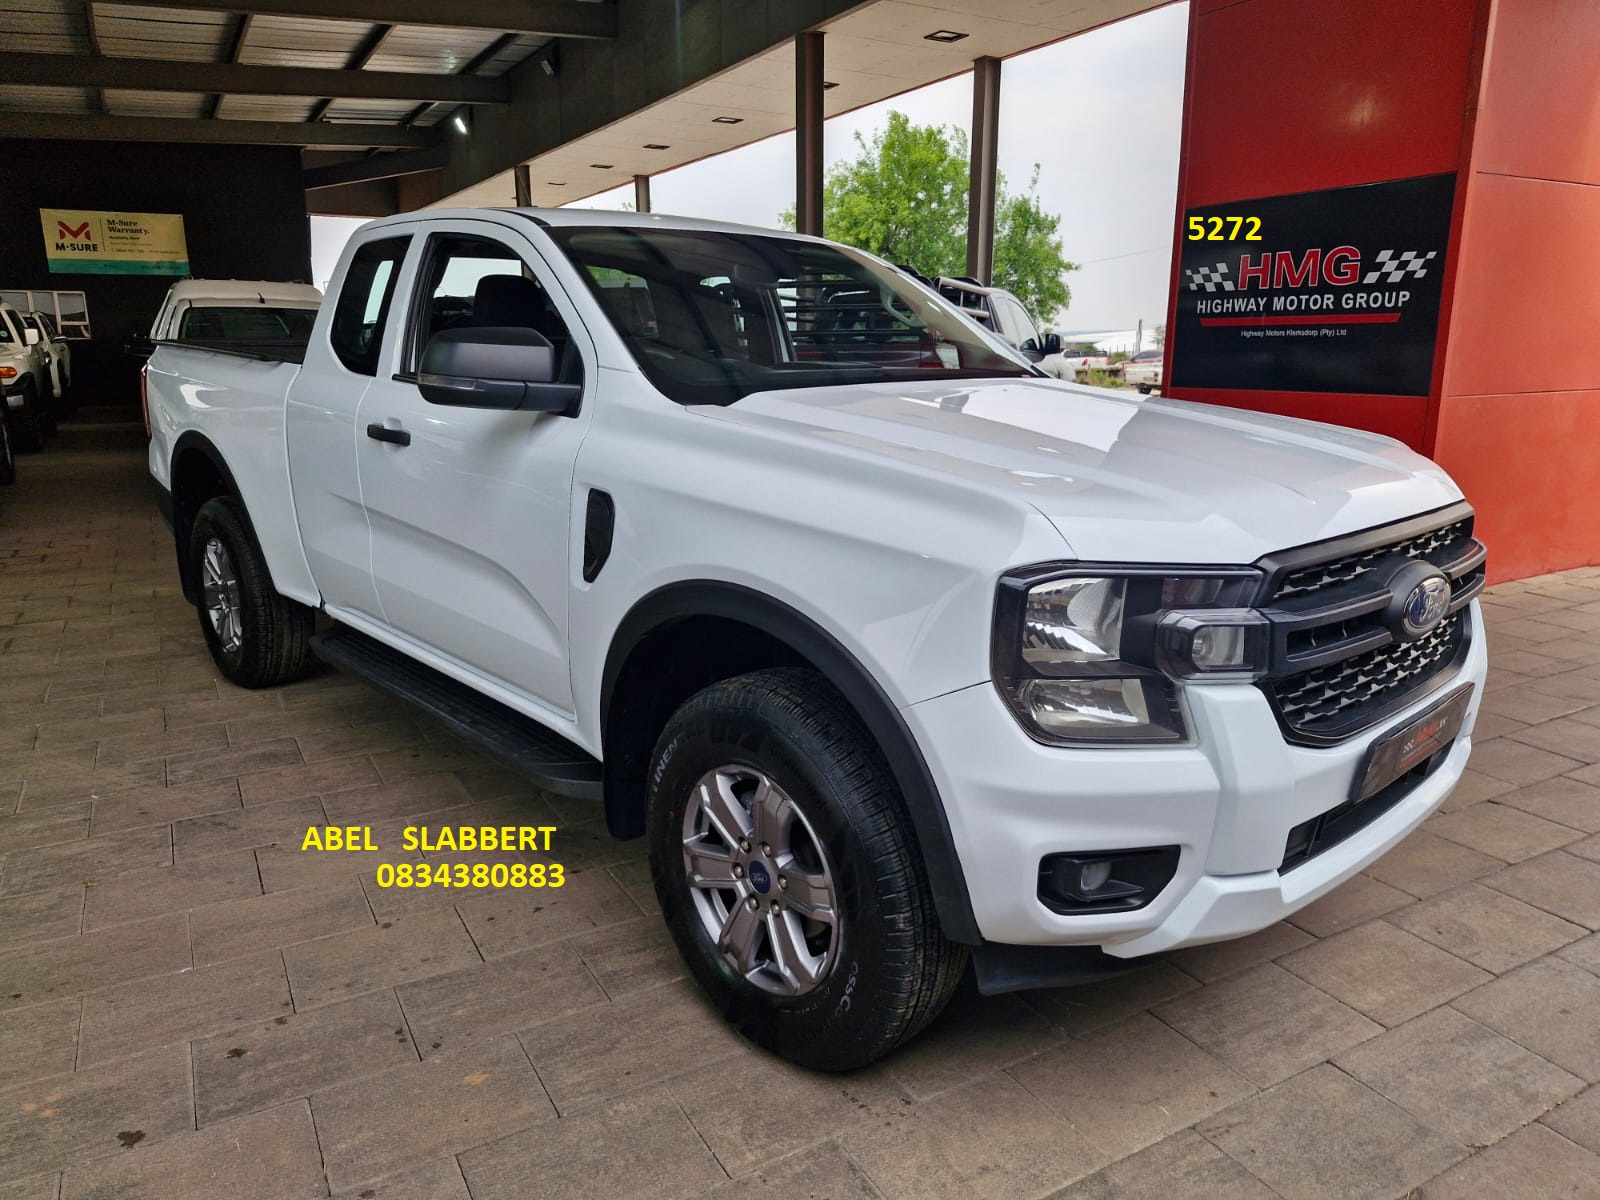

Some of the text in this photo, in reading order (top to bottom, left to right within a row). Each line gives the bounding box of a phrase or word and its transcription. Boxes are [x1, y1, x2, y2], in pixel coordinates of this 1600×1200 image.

[107, 219, 138, 227] M-Sure
[107, 226, 150, 236] Warranty.
[1238, 246, 1361, 291] HMG
[1196, 290, 1411, 315] HIGHWAY MOTOR GROUP
[1240, 328, 1347, 339] Highway Motors Klerksdorp (Pty) Ltd
